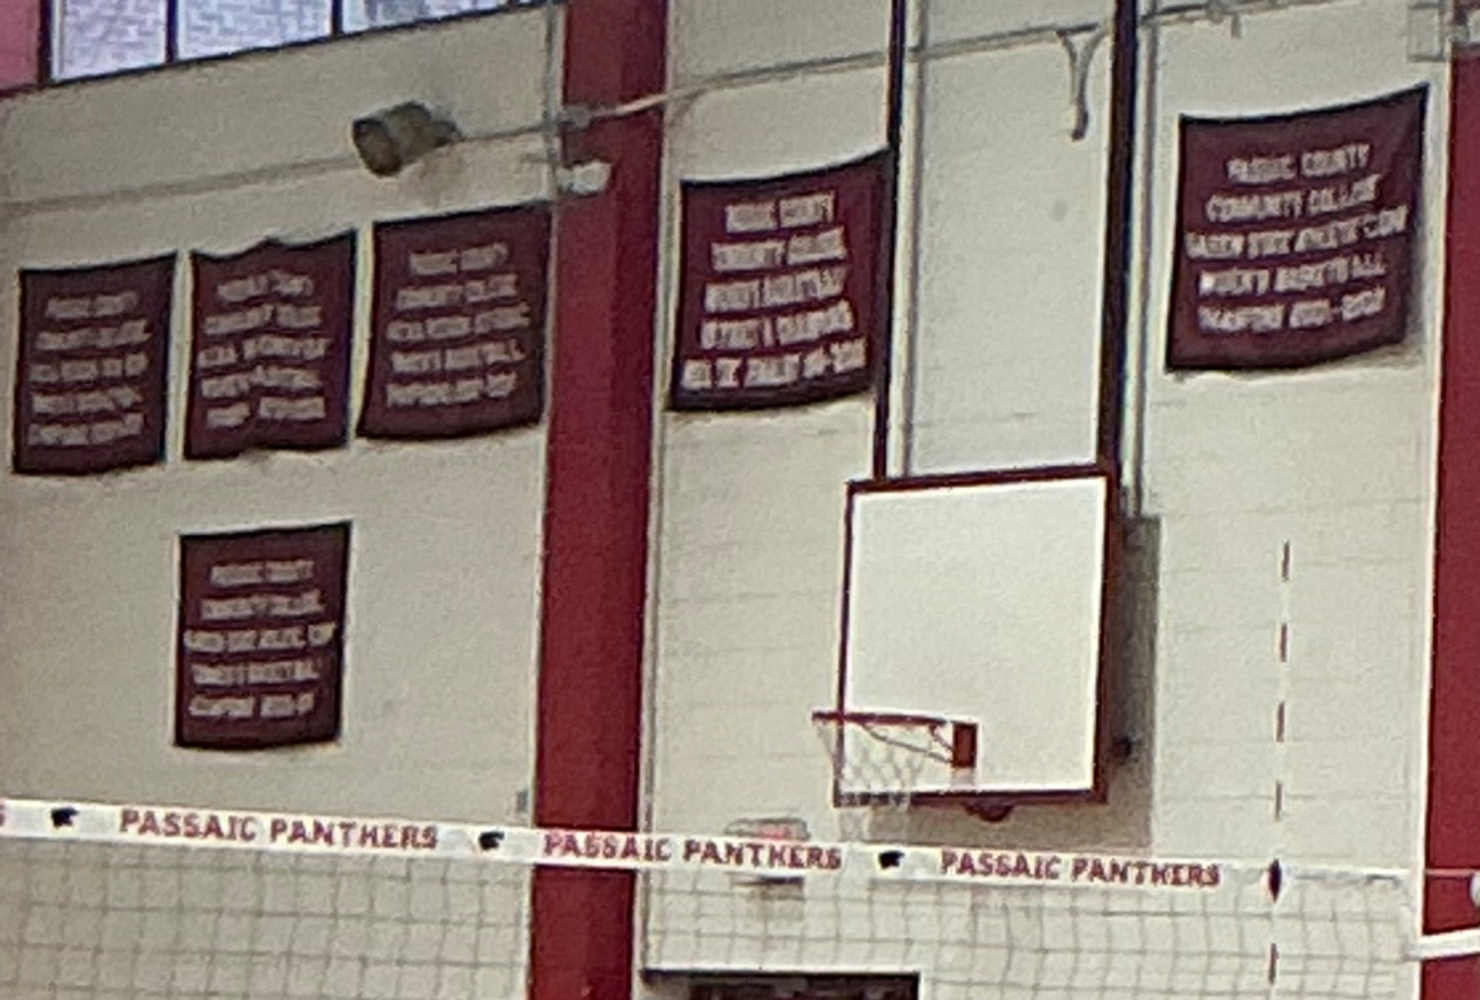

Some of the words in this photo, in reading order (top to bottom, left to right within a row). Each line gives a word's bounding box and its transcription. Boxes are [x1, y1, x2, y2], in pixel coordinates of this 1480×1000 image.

[119, 808, 256, 841] PASSAIC
[268, 817, 438, 850] PANTHERS
[542, 831, 671, 861] PASSAIC
[682, 838, 842, 870] PANTHERS
[941, 848, 1060, 879] PASSAIC
[1072, 857, 1220, 888] PANTHERS
